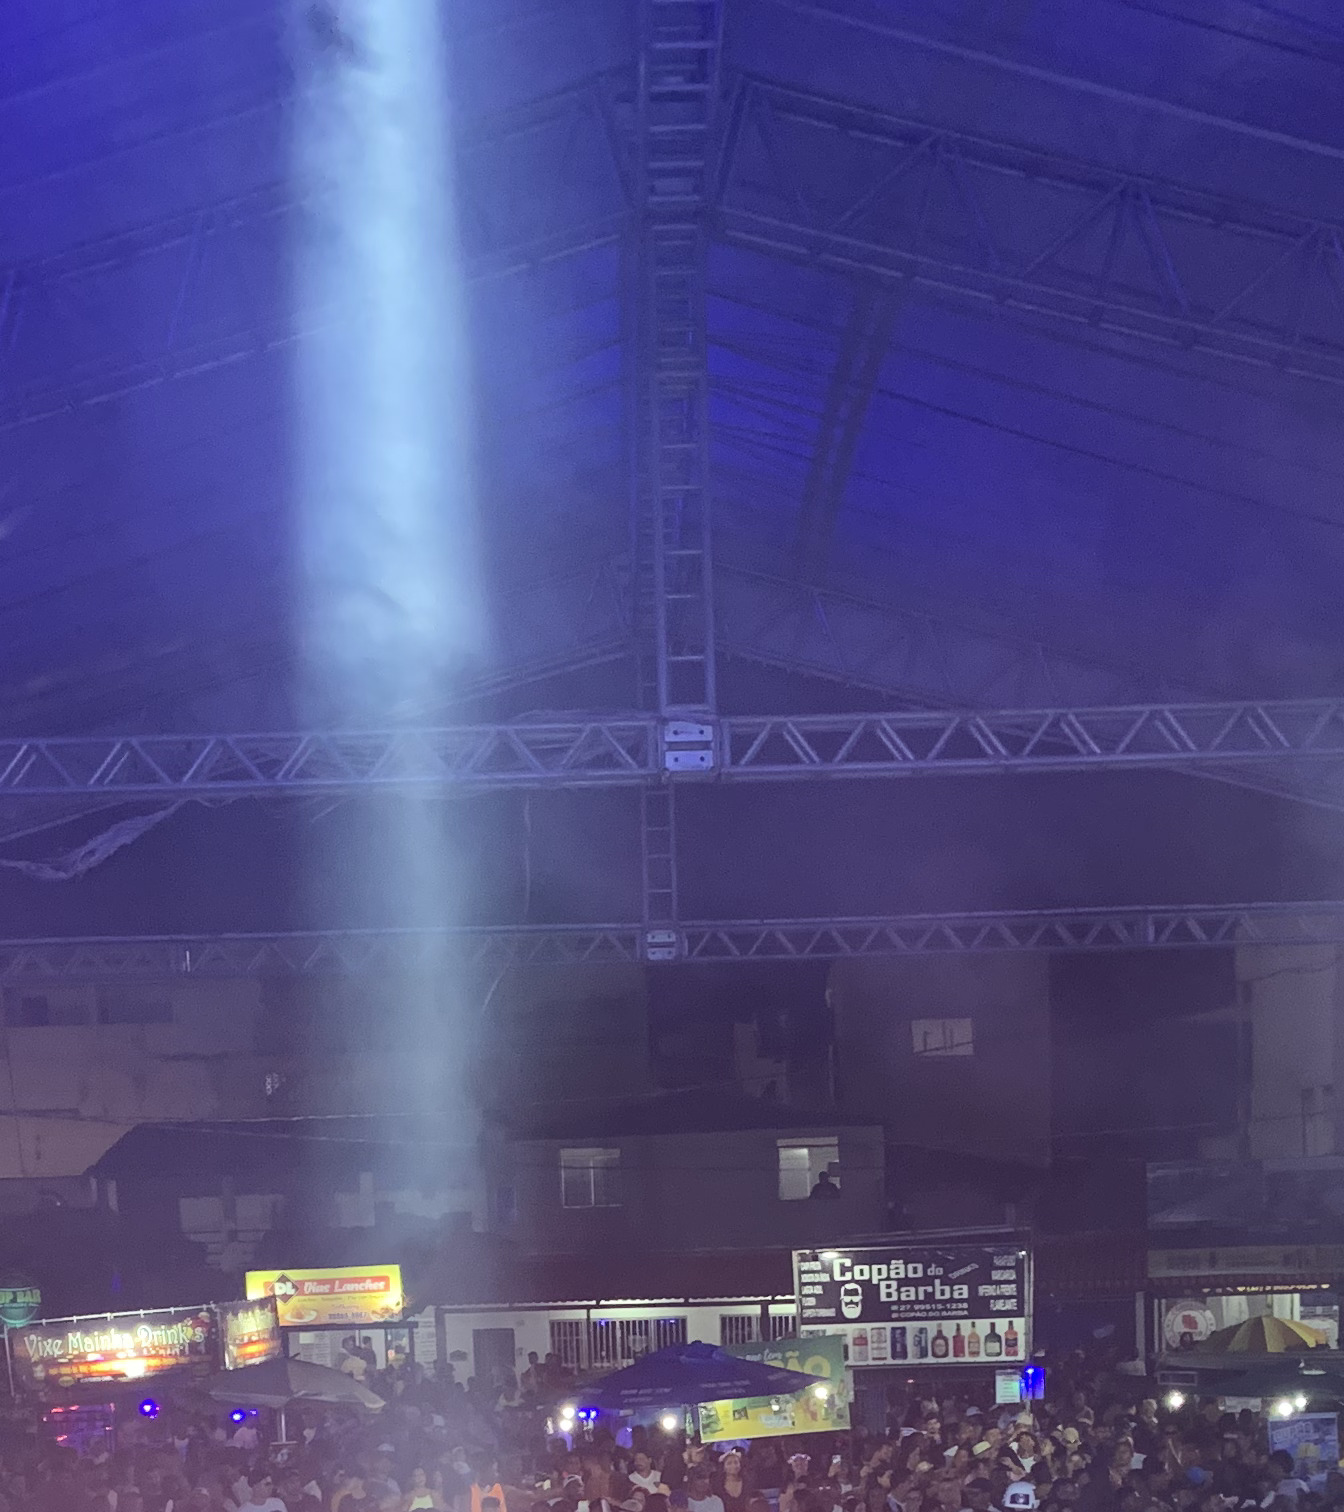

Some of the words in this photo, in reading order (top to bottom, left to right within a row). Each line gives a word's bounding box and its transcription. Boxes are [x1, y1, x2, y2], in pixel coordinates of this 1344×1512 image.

[832, 1257, 923, 1285] Copão
[927, 1263, 944, 1277] do
[274, 1280, 296, 1295] DL
[334, 1278, 386, 1293] Lanches
[879, 1279, 969, 1302] Barba
